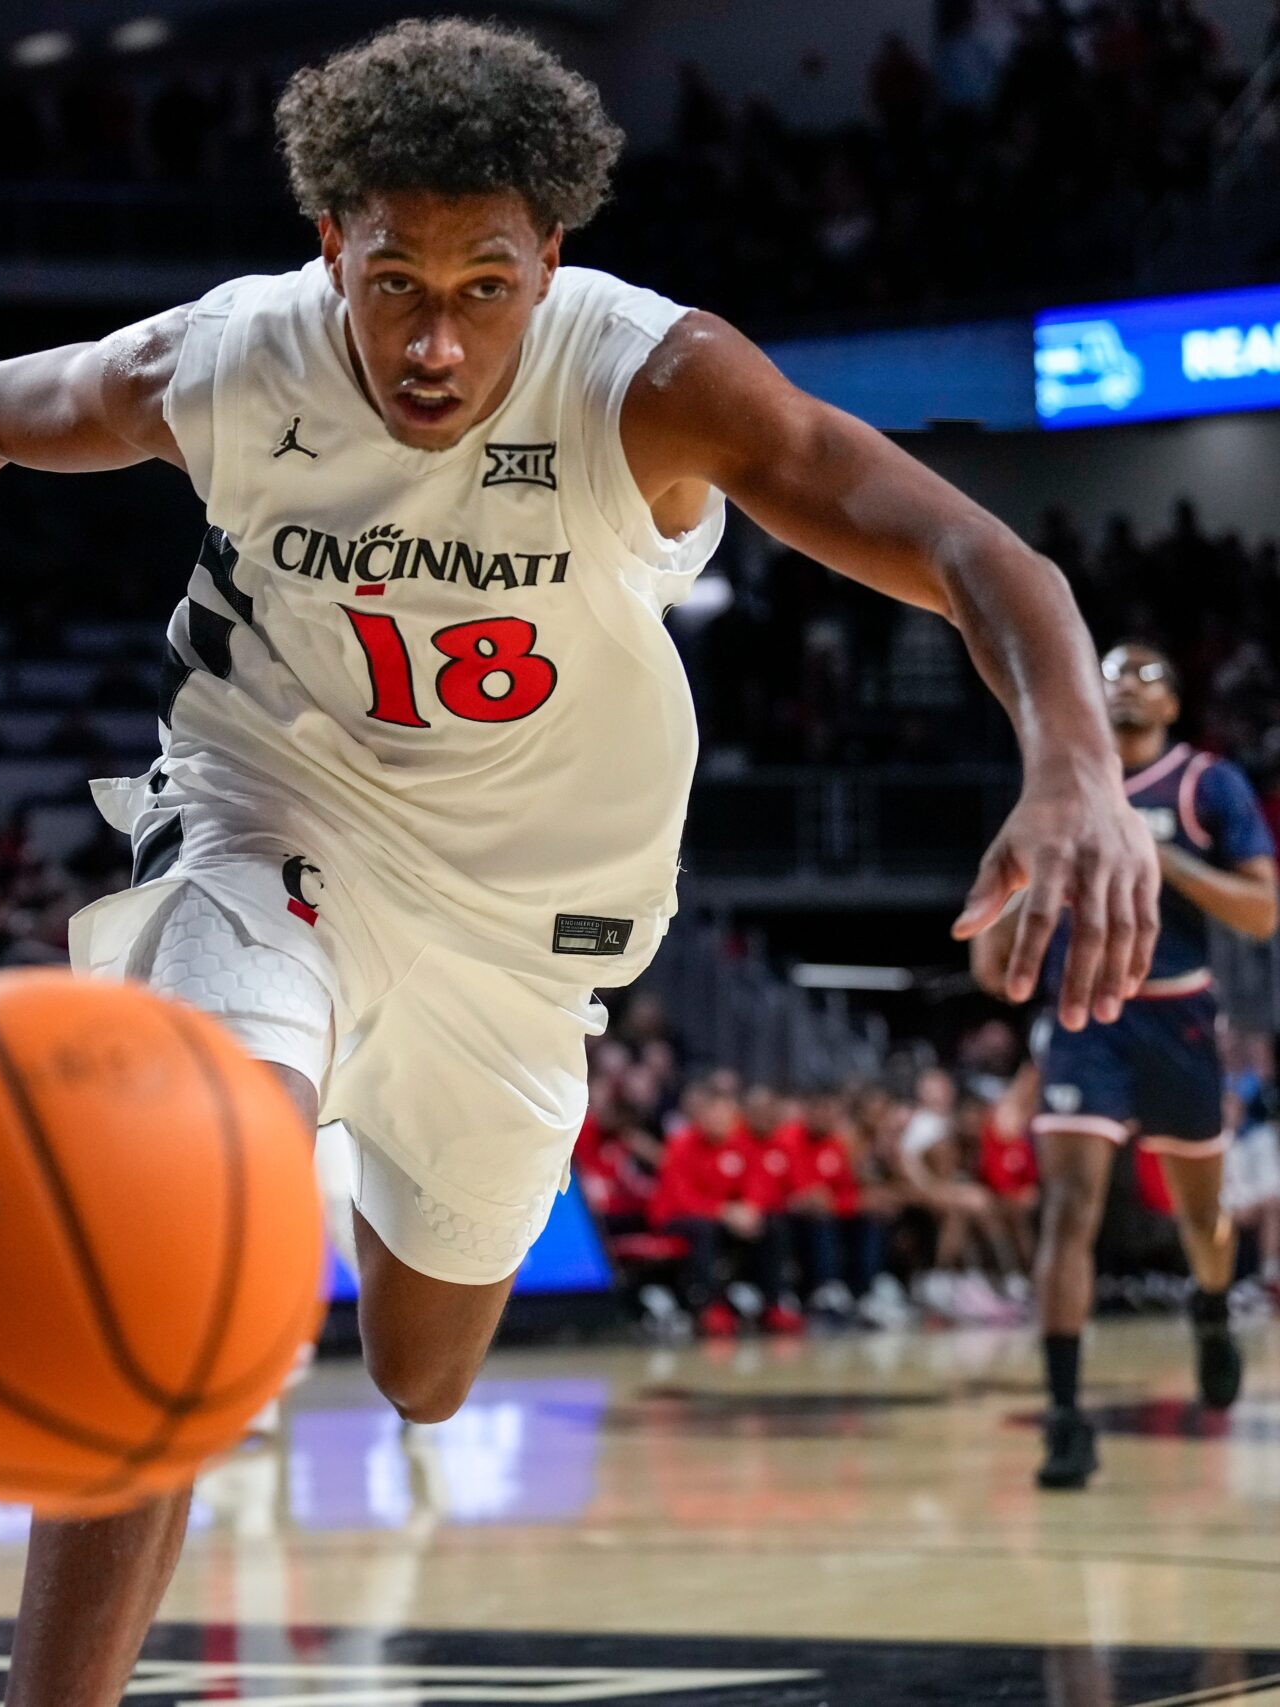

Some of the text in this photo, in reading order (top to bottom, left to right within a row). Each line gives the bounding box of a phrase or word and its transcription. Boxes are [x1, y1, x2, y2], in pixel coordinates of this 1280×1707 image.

[1182, 322, 1280, 381] REA
[488, 447, 556, 486] XII
[272, 524, 571, 591] CINCINNATI
[330, 602, 558, 728] 18
[604, 929, 620, 944] XL
